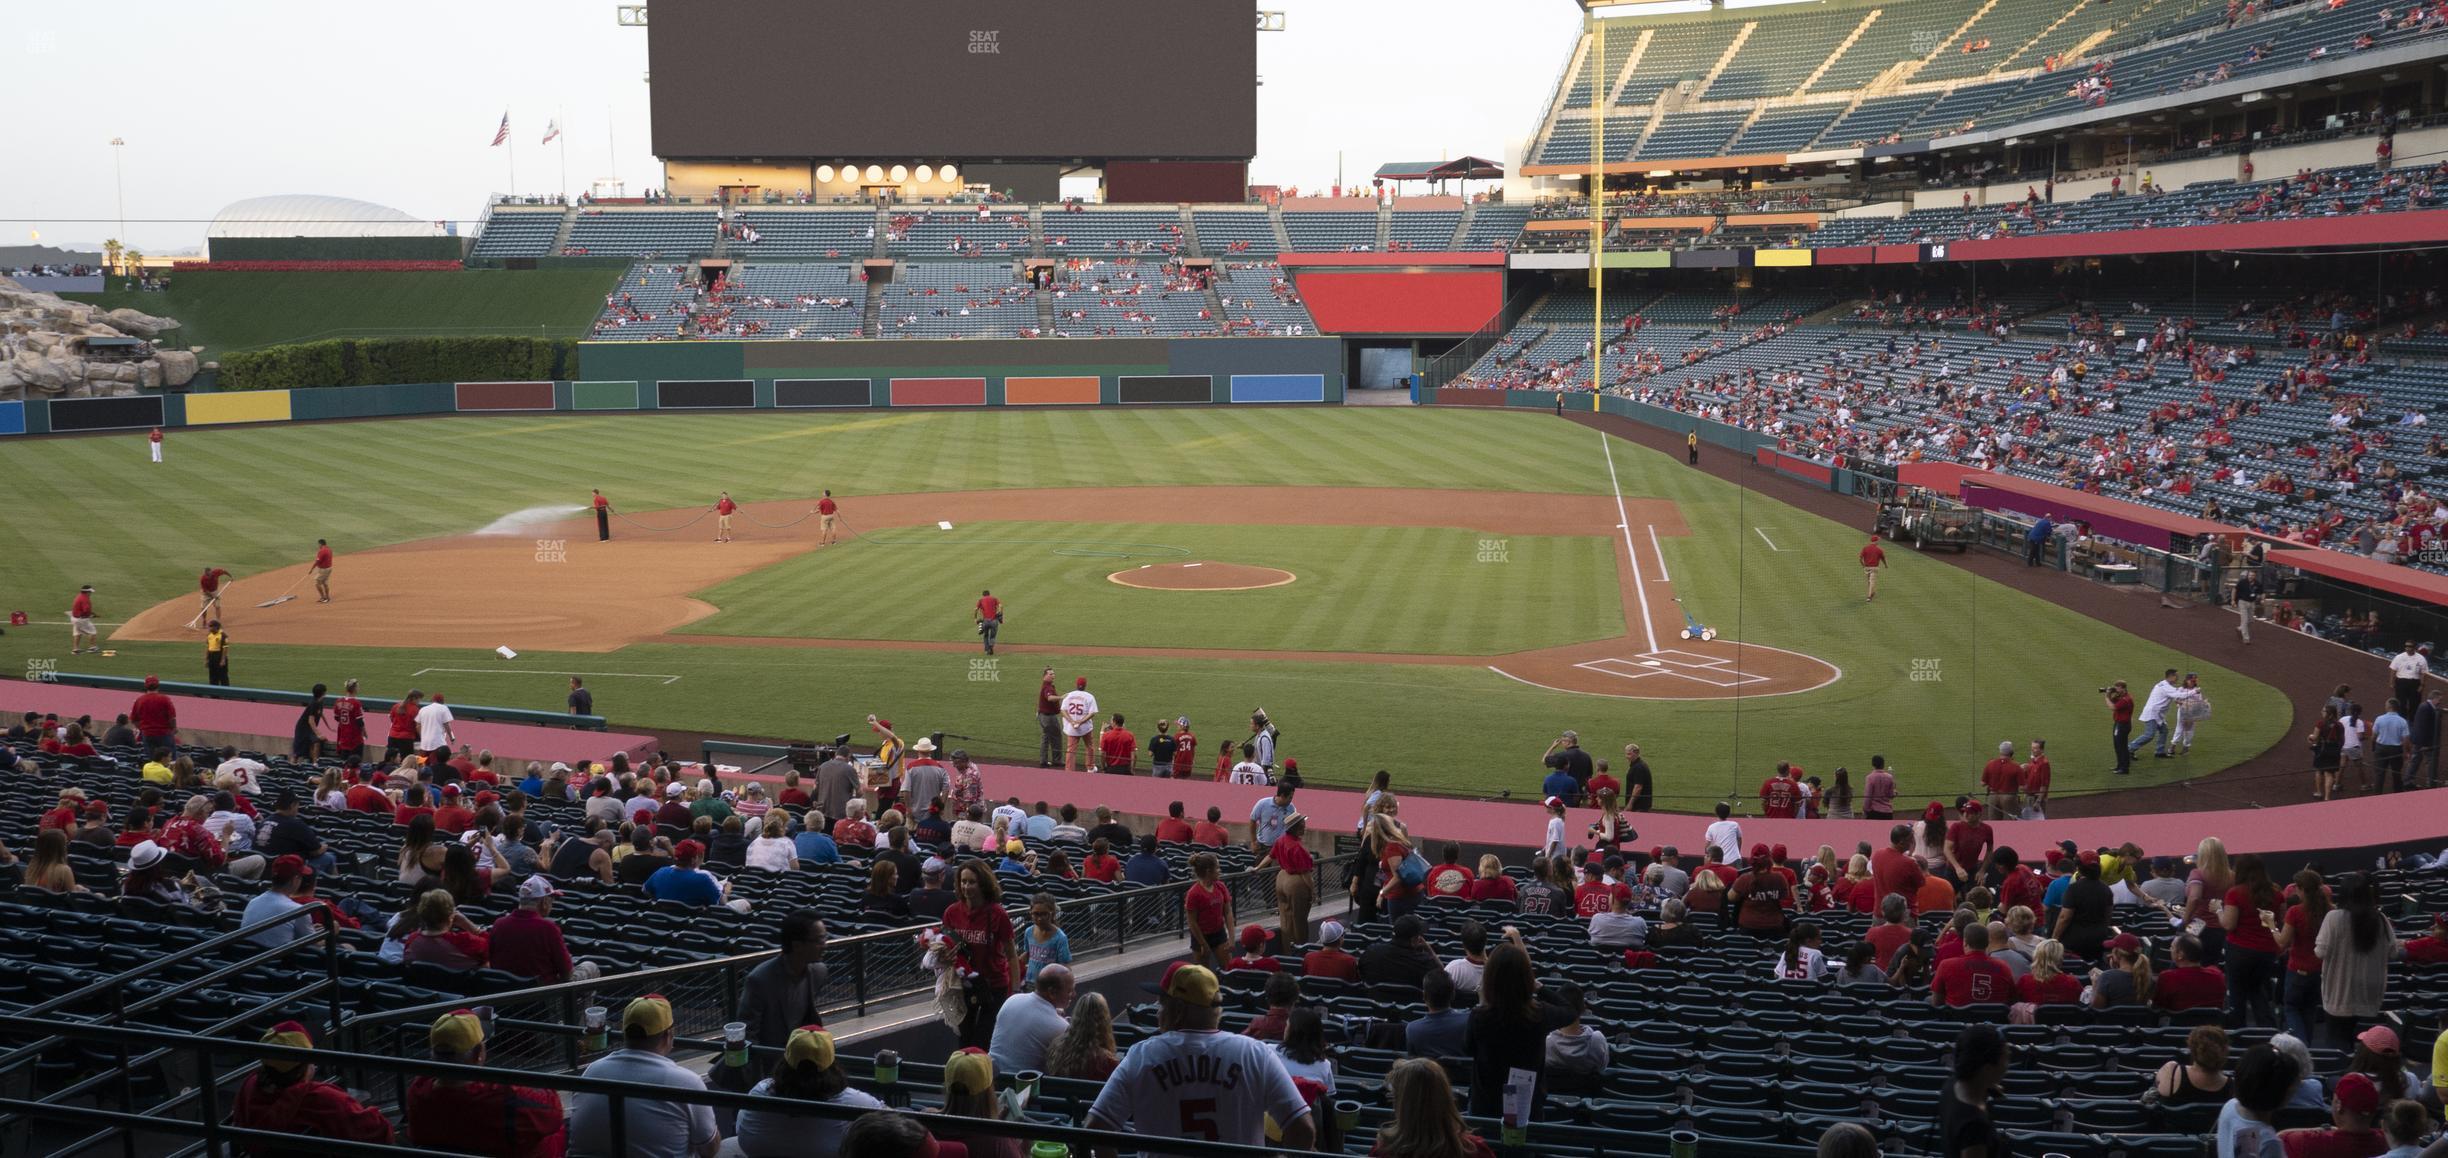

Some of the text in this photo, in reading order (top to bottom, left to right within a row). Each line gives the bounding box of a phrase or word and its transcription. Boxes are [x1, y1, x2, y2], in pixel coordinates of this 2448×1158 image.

[1069, 703, 1084, 715] 25
[1179, 741, 1191, 752] 34
[233, 768, 248, 785] 3
[1240, 774, 1254, 785] 13
[1525, 897, 1552, 914] 27
[1581, 893, 1610, 912] 48
[1825, 894, 1835, 908] 3
[1972, 973, 1992, 1001] 5
[1152, 1054, 1242, 1091] PUJOLS
[1180, 1098, 1219, 1142] 5
